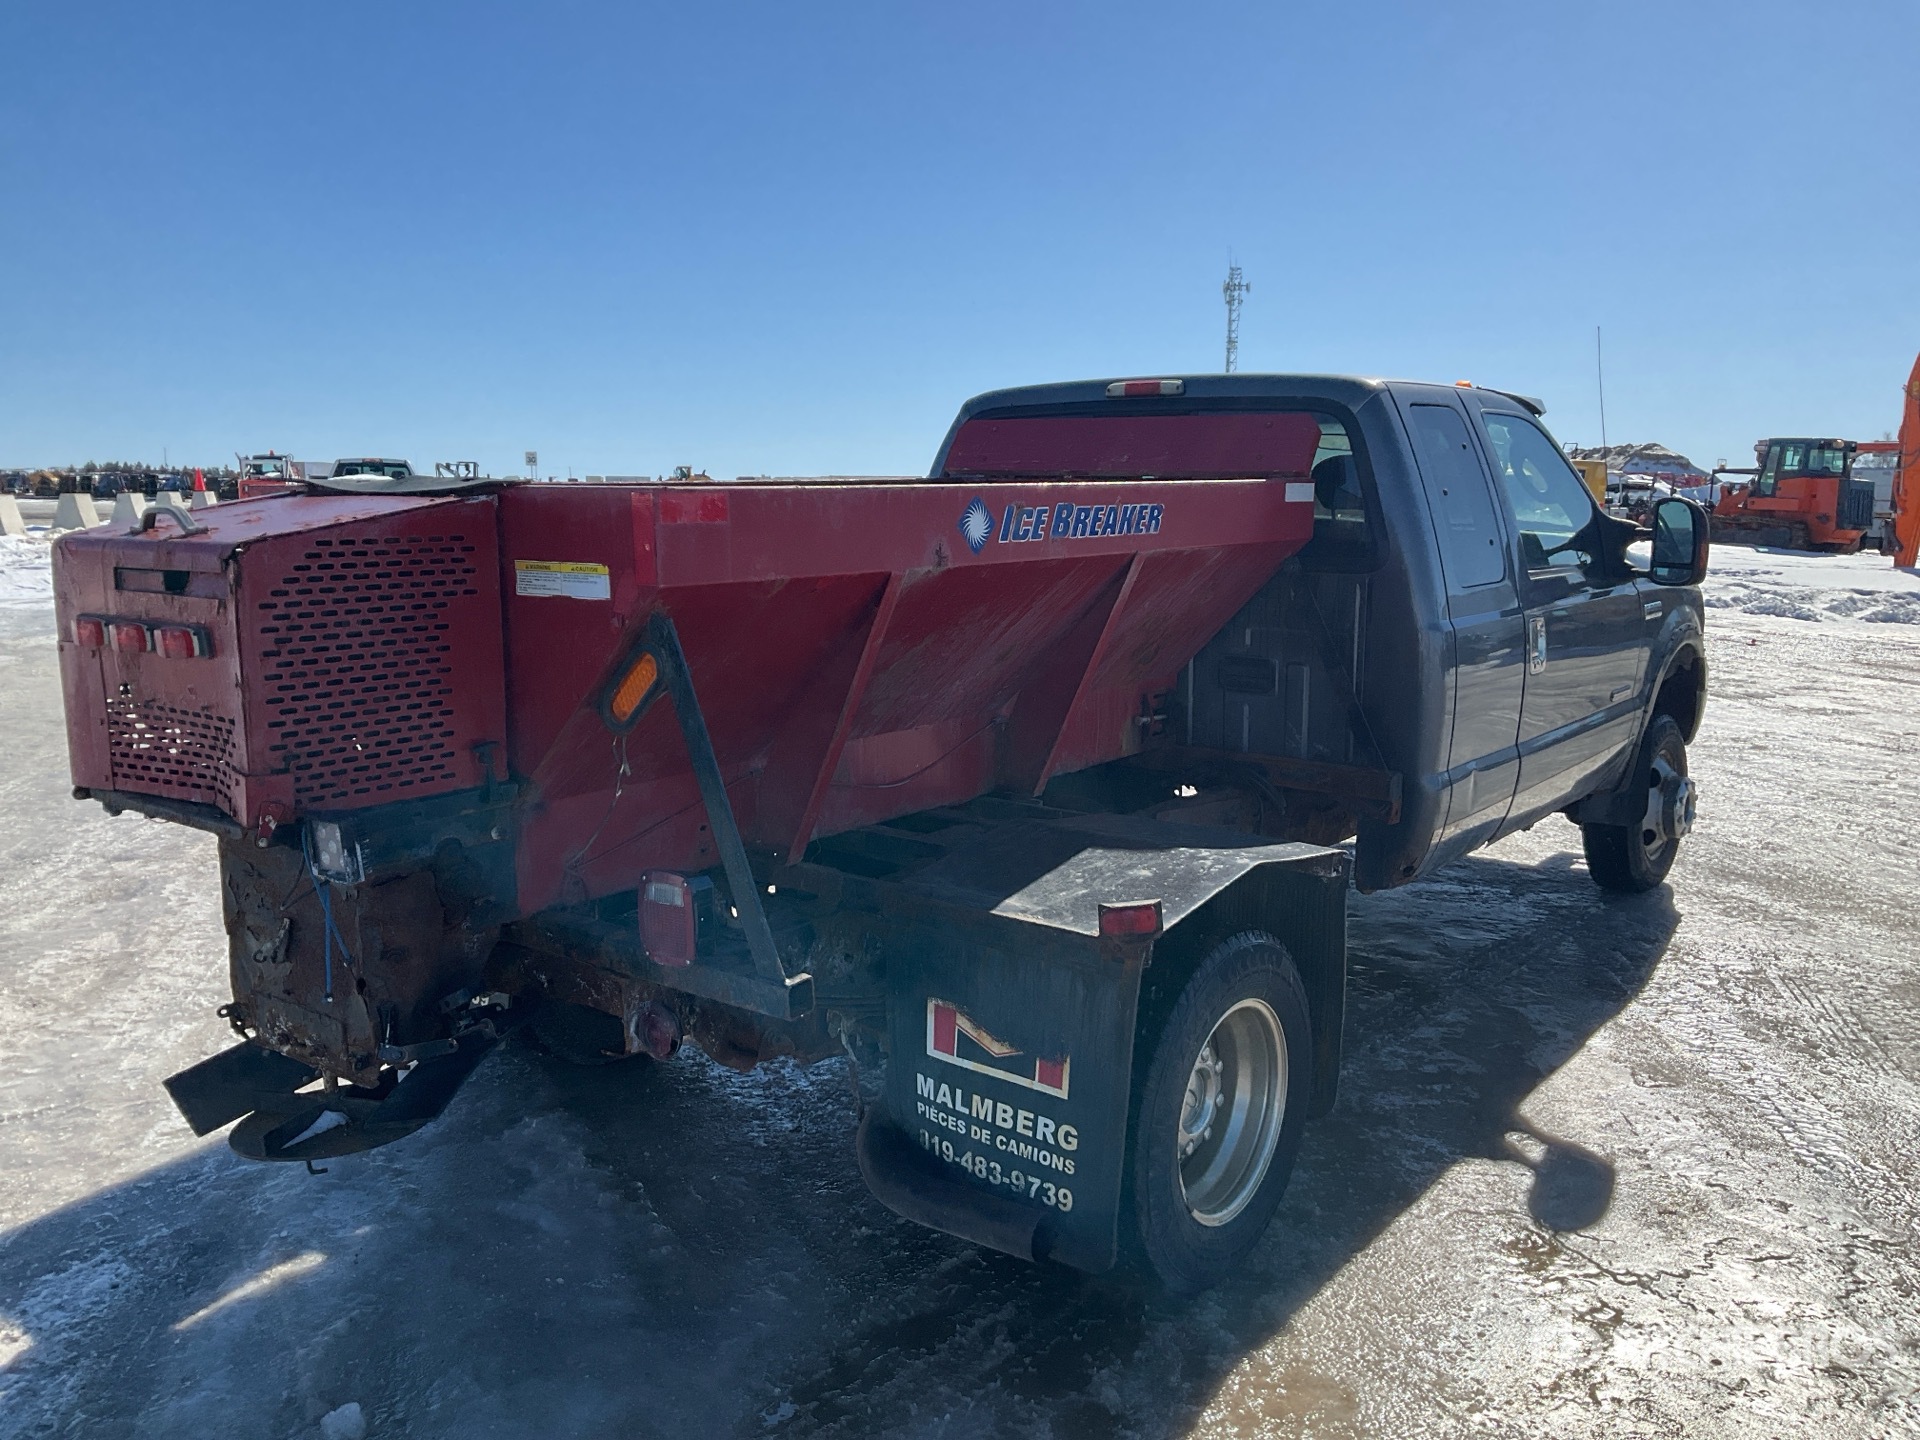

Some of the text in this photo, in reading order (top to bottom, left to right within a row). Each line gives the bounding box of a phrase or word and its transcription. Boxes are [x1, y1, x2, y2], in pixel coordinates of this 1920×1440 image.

[998, 502, 1165, 543] ICE BREAKER
[916, 1072, 1079, 1151] MALMBERG
[917, 1101, 1075, 1175] PIÈCES DE CAMIONS
